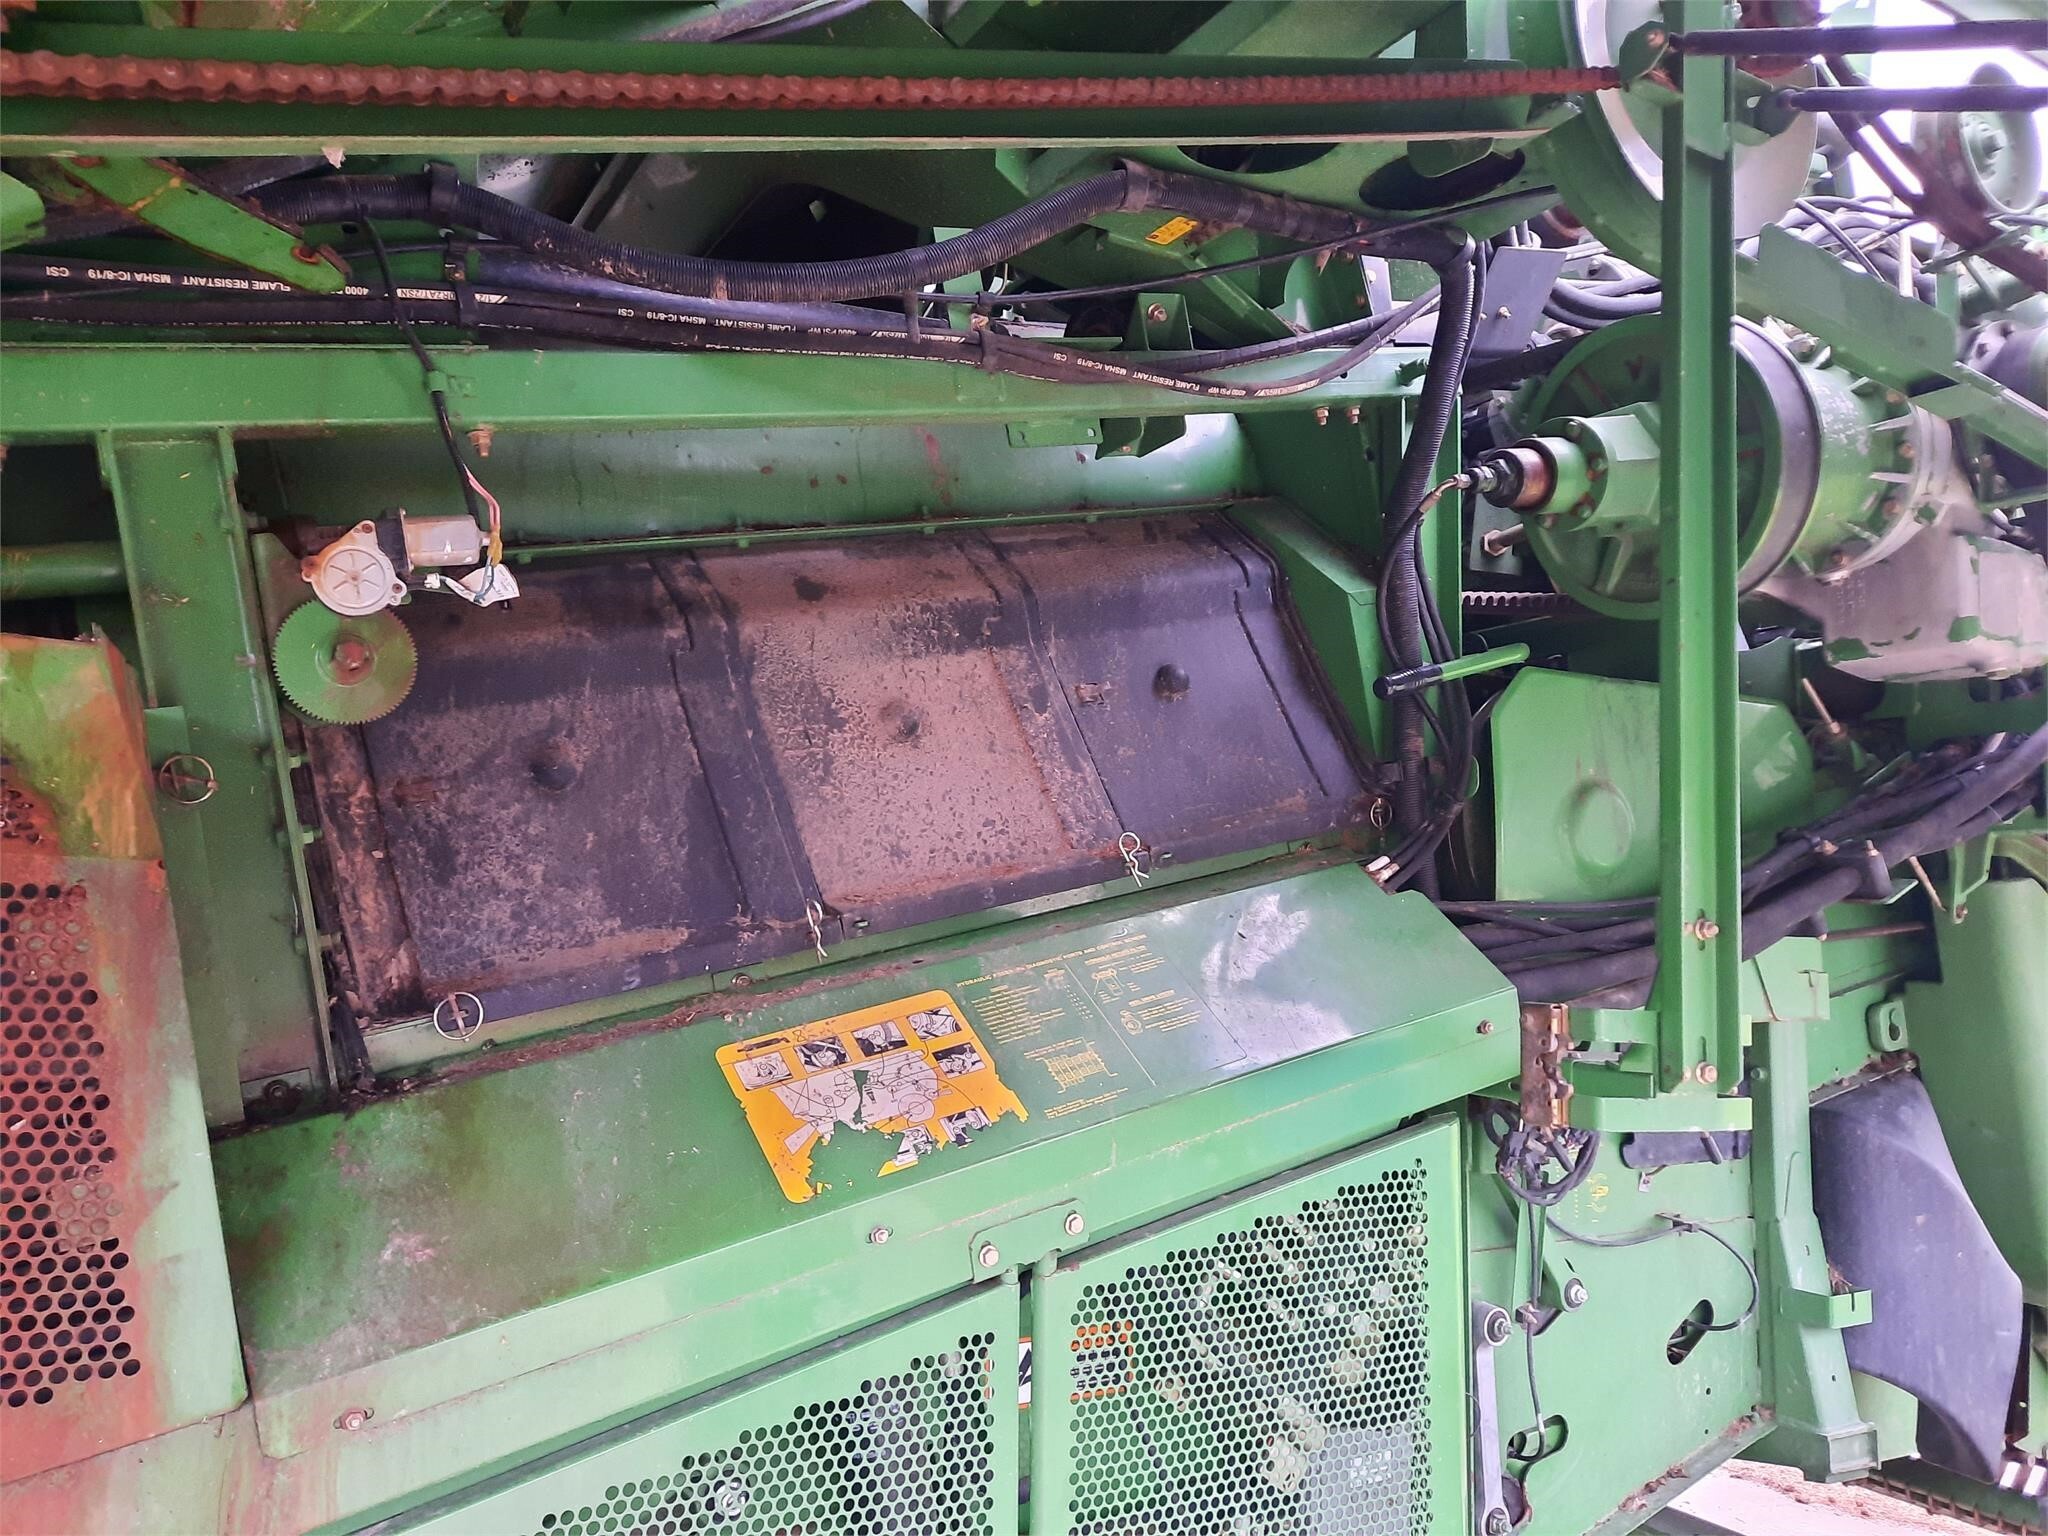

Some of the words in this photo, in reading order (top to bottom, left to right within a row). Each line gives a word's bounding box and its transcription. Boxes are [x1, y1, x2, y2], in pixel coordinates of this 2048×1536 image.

[46, 266, 70, 277] CSI
[88, 269, 131, 281] IC-8/19
[133, 271, 171, 284] MSHA
[181, 276, 248, 290] RESISTANT
[252, 280, 291, 293] FLAME
[345, 286, 369, 296] 4000
[617, 308, 635, 318] CSI
[646, 311, 677, 322] IC-8/19
[678, 314, 706, 325] MSHA
[713, 318, 765, 330] RESISTANT
[766, 322, 797, 333] FLAME
[1053, 352, 1068, 362] CSI
[1076, 357, 1103, 370] IC-8/19
[1104, 363, 1127, 376] MSHA
[1131, 371, 1175, 386] RESISTANT
[1174, 378, 1200, 391] FLAME
